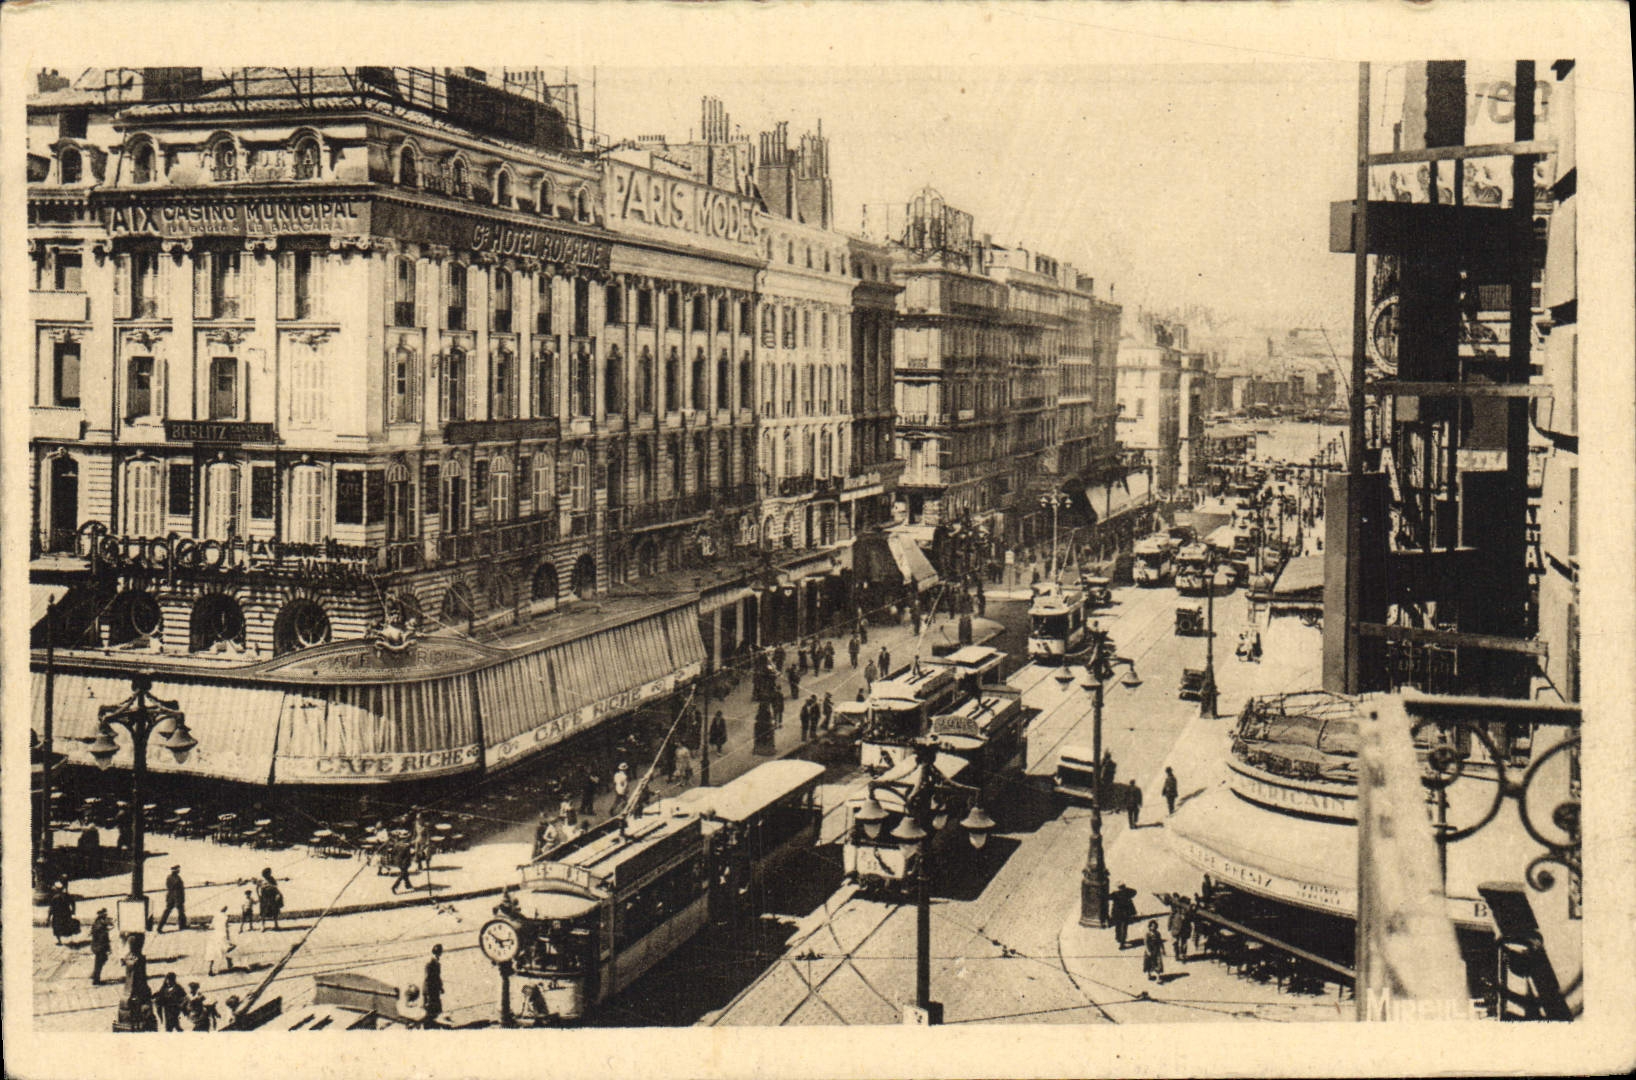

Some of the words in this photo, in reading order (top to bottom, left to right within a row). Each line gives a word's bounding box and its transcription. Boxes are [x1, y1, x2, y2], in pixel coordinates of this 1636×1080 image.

[111, 205, 160, 233] AIX
[161, 203, 237, 222] CASINO
[244, 200, 358, 220] MUNICIPAL
[271, 223, 344, 233] BACCARA
[172, 424, 227, 439] BERLITZ
[316, 652, 369, 673] CAFE
[534, 711, 584, 742] CAFE
[592, 686, 642, 716] RICHE
[316, 756, 393, 774] CAFE
[400, 748, 464, 772] RICHE
